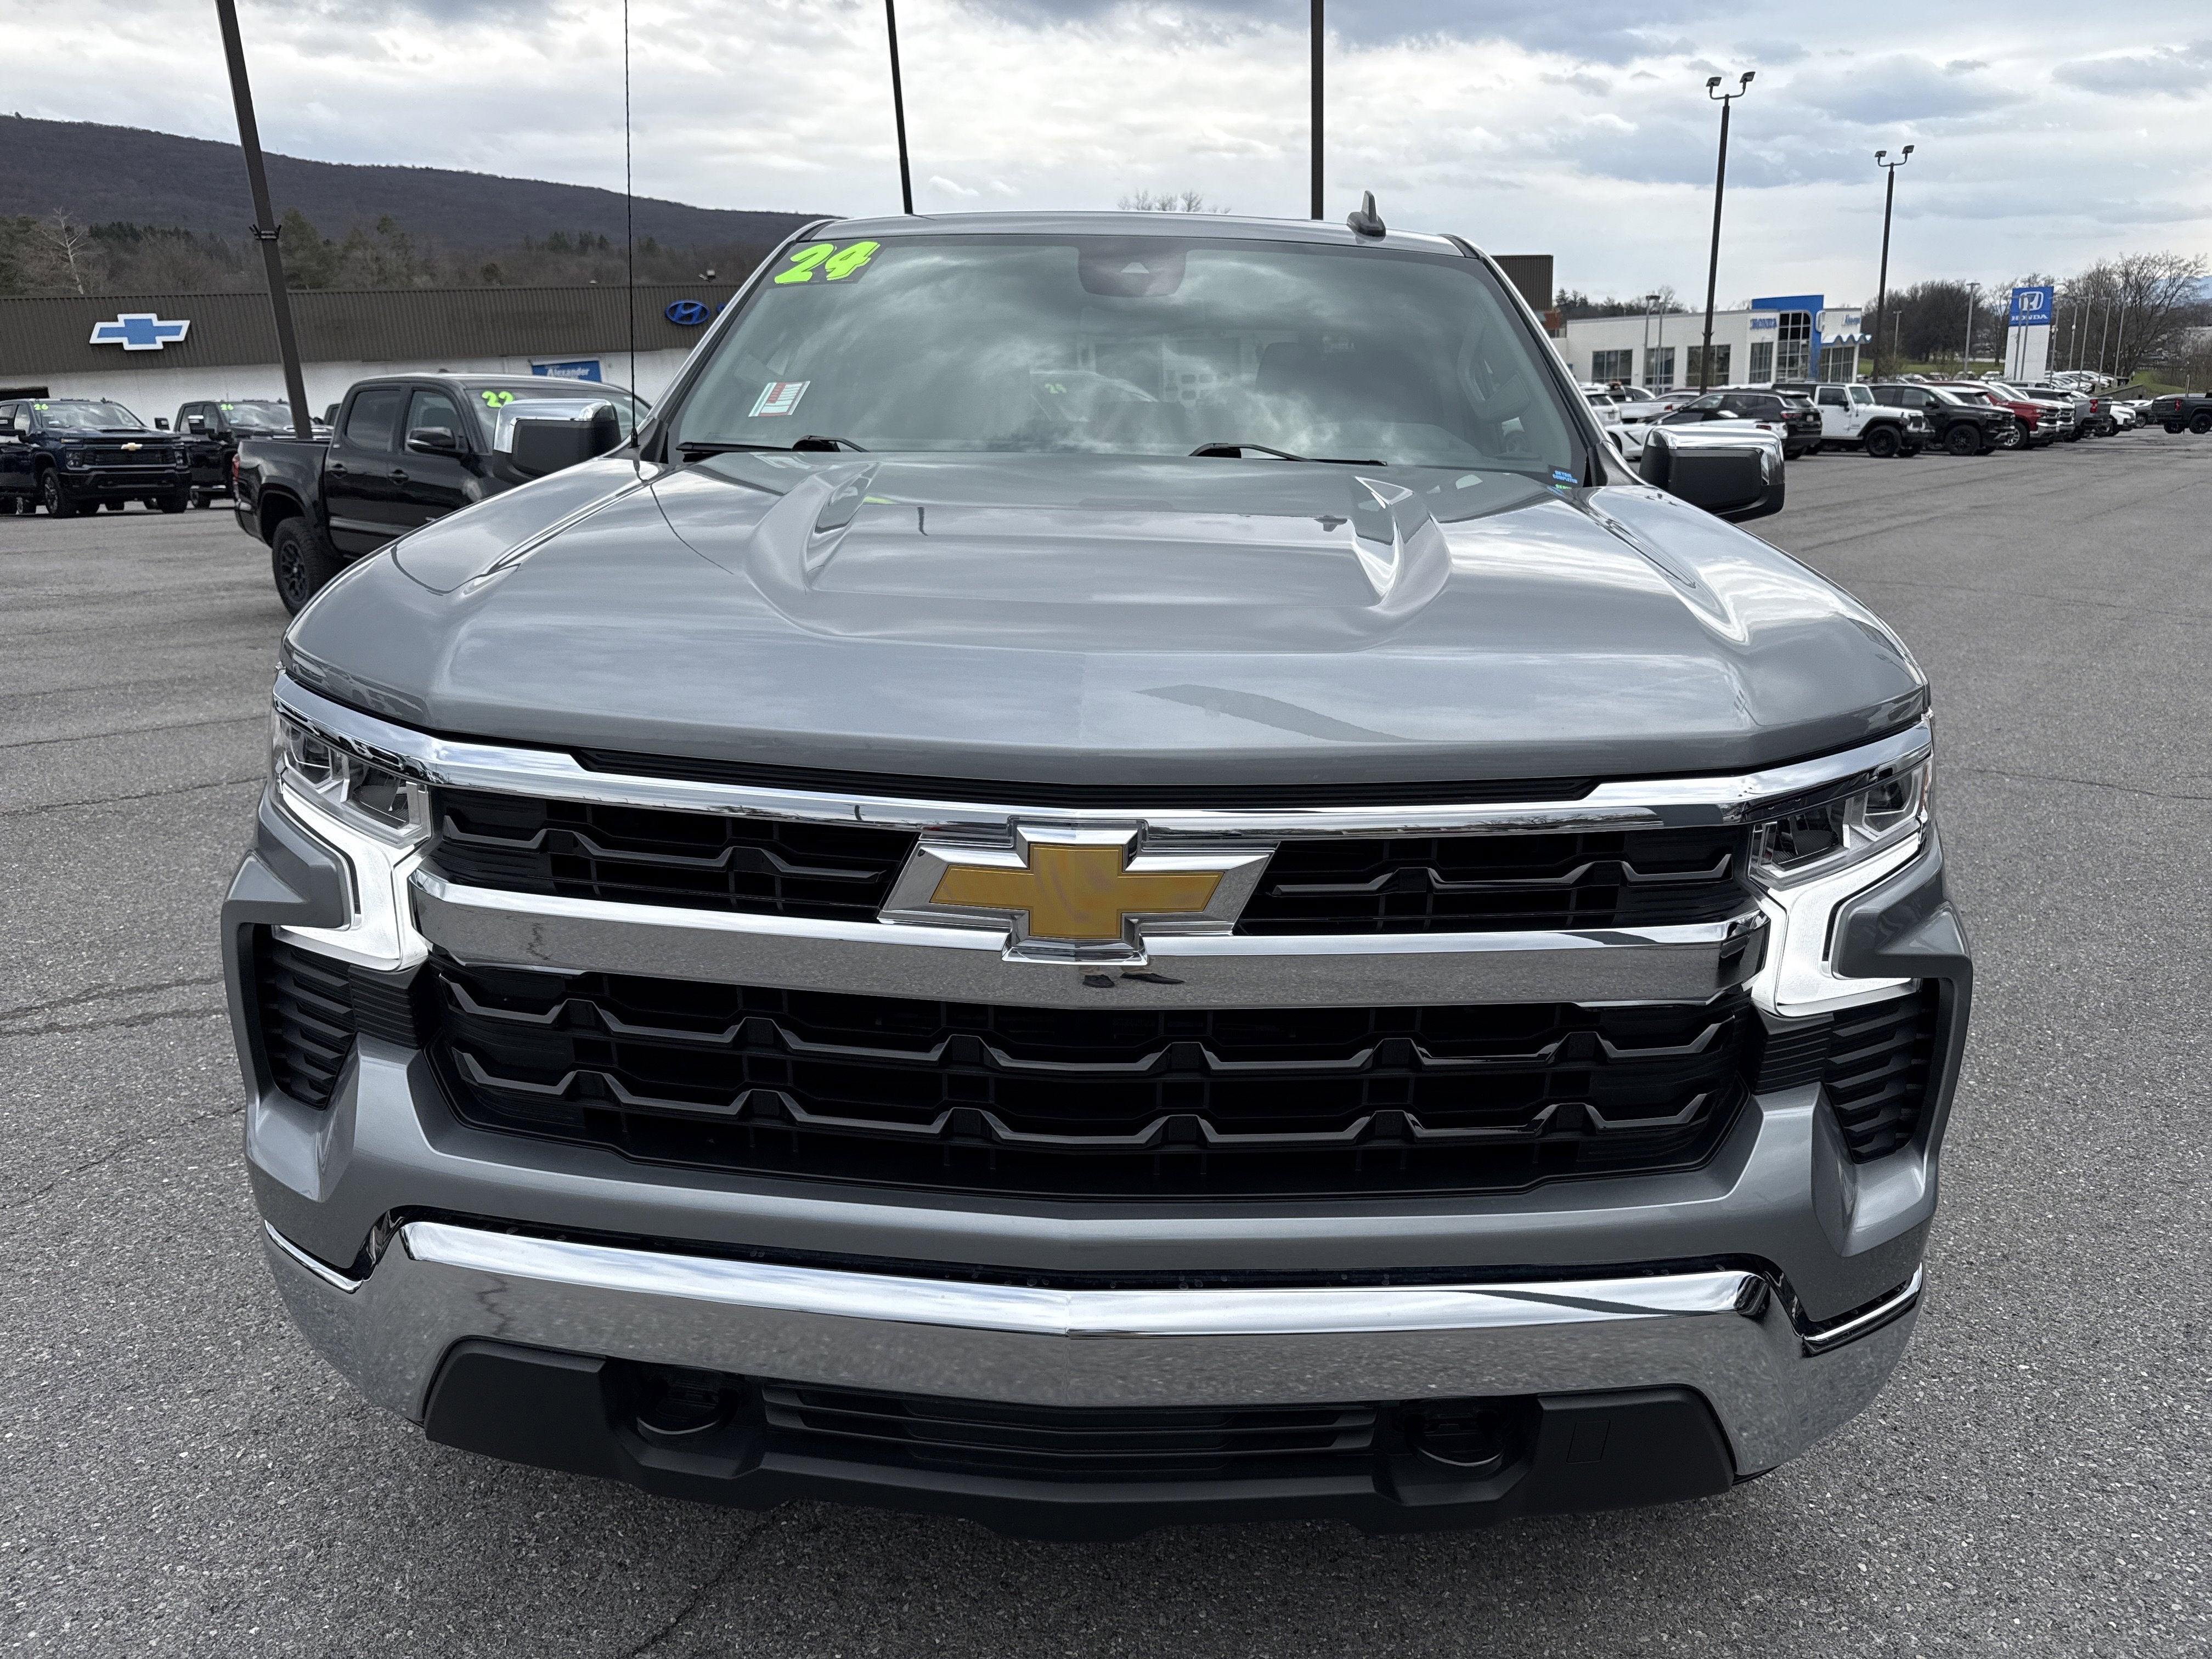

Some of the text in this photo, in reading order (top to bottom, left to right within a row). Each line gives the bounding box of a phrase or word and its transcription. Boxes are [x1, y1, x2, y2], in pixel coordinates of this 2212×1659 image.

[774, 241, 880, 284] 24
[547, 366, 590, 377] Alexander
[482, 391, 514, 407] 22
